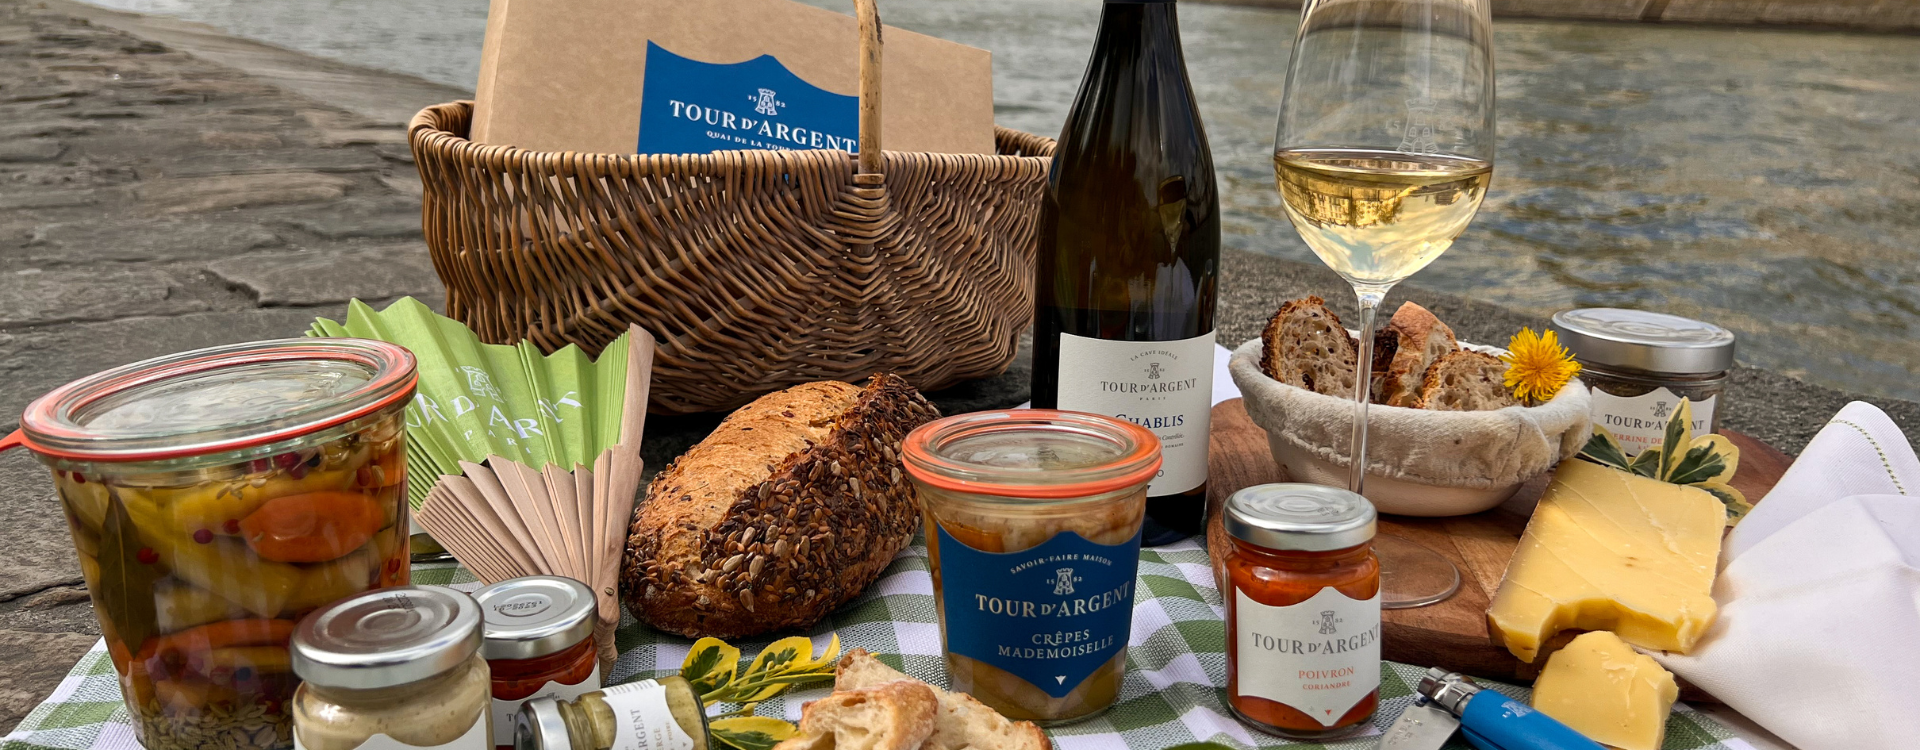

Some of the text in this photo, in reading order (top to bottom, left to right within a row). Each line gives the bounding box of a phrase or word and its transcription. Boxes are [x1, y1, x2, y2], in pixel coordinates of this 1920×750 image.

[669, 99, 857, 154] TOUR D'ARGENT
[706, 130, 731, 142] QUAI
[734, 136, 747, 144] DE
[750, 139, 763, 148] LA
[1100, 377, 1197, 393] TOUR D'ARGENT
[1604, 413, 1704, 431] TOUR D'ANT
[1612, 433, 1648, 443] ERRINE
[1010, 554, 1113, 574] SAVOIR-FAIRE MAISON
[974, 580, 1130, 619] TOUR D'ARGENT
[1031, 628, 1090, 647] CRÊPES
[1251, 622, 1380, 655] TOUR D'ARGENT
[998, 635, 1114, 660] MADEMOISELLE
[1298, 666, 1355, 679] POIVRON
[1302, 680, 1352, 690] CORIANDRE
